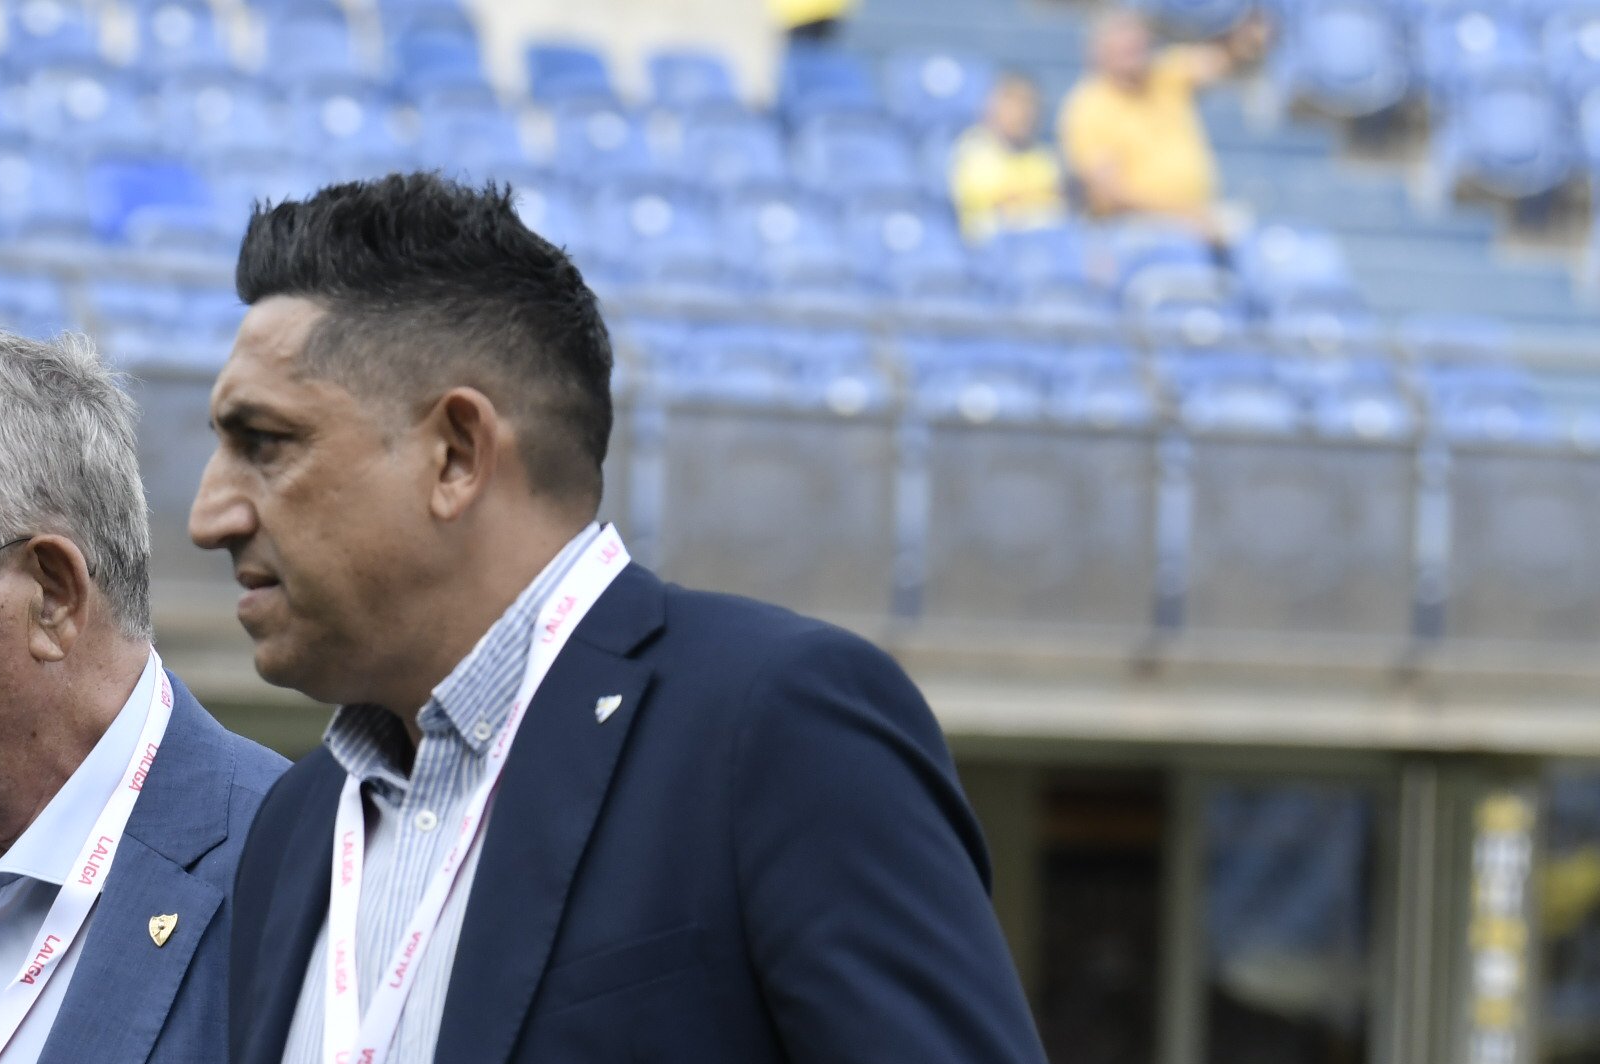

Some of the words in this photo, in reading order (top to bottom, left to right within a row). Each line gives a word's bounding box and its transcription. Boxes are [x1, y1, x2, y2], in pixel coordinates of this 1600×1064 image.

[542, 595, 578, 644] LALIGA
[128, 742, 160, 793] LALIGA
[78, 835, 114, 886] LALIGA
[341, 830, 355, 887] LALIGA
[19, 934, 61, 985] LALIGA
[390, 930, 423, 989] LALIGA
